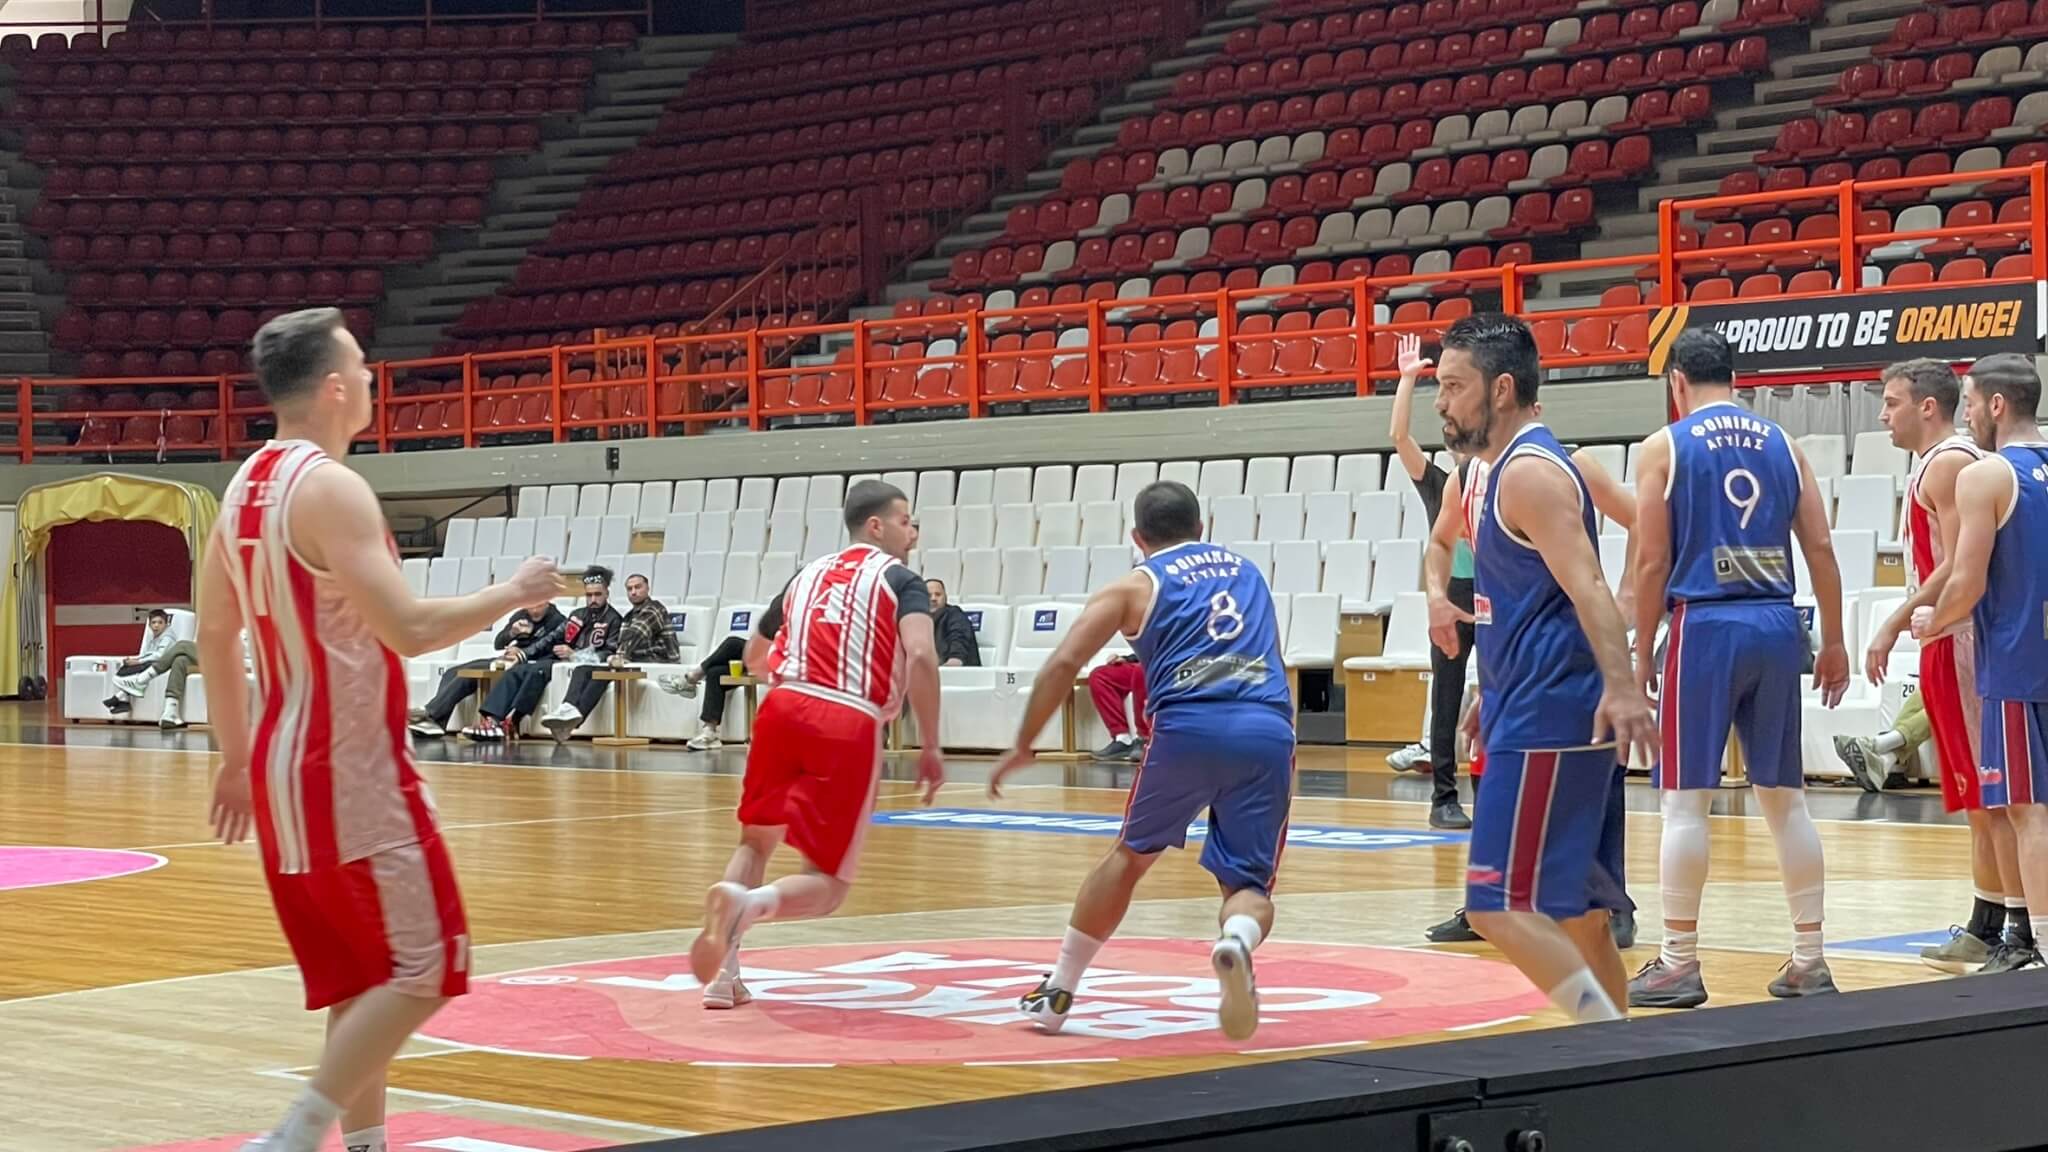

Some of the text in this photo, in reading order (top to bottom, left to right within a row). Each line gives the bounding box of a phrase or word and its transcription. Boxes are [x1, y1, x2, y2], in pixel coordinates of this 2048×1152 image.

[1815, 312, 1850, 350] TO
[1852, 309, 1894, 346] BE
[1895, 300, 2022, 344] ORANGE!
[1724, 468, 1759, 529] 9
[809, 582, 846, 624] 4
[1207, 590, 1244, 641] 8
